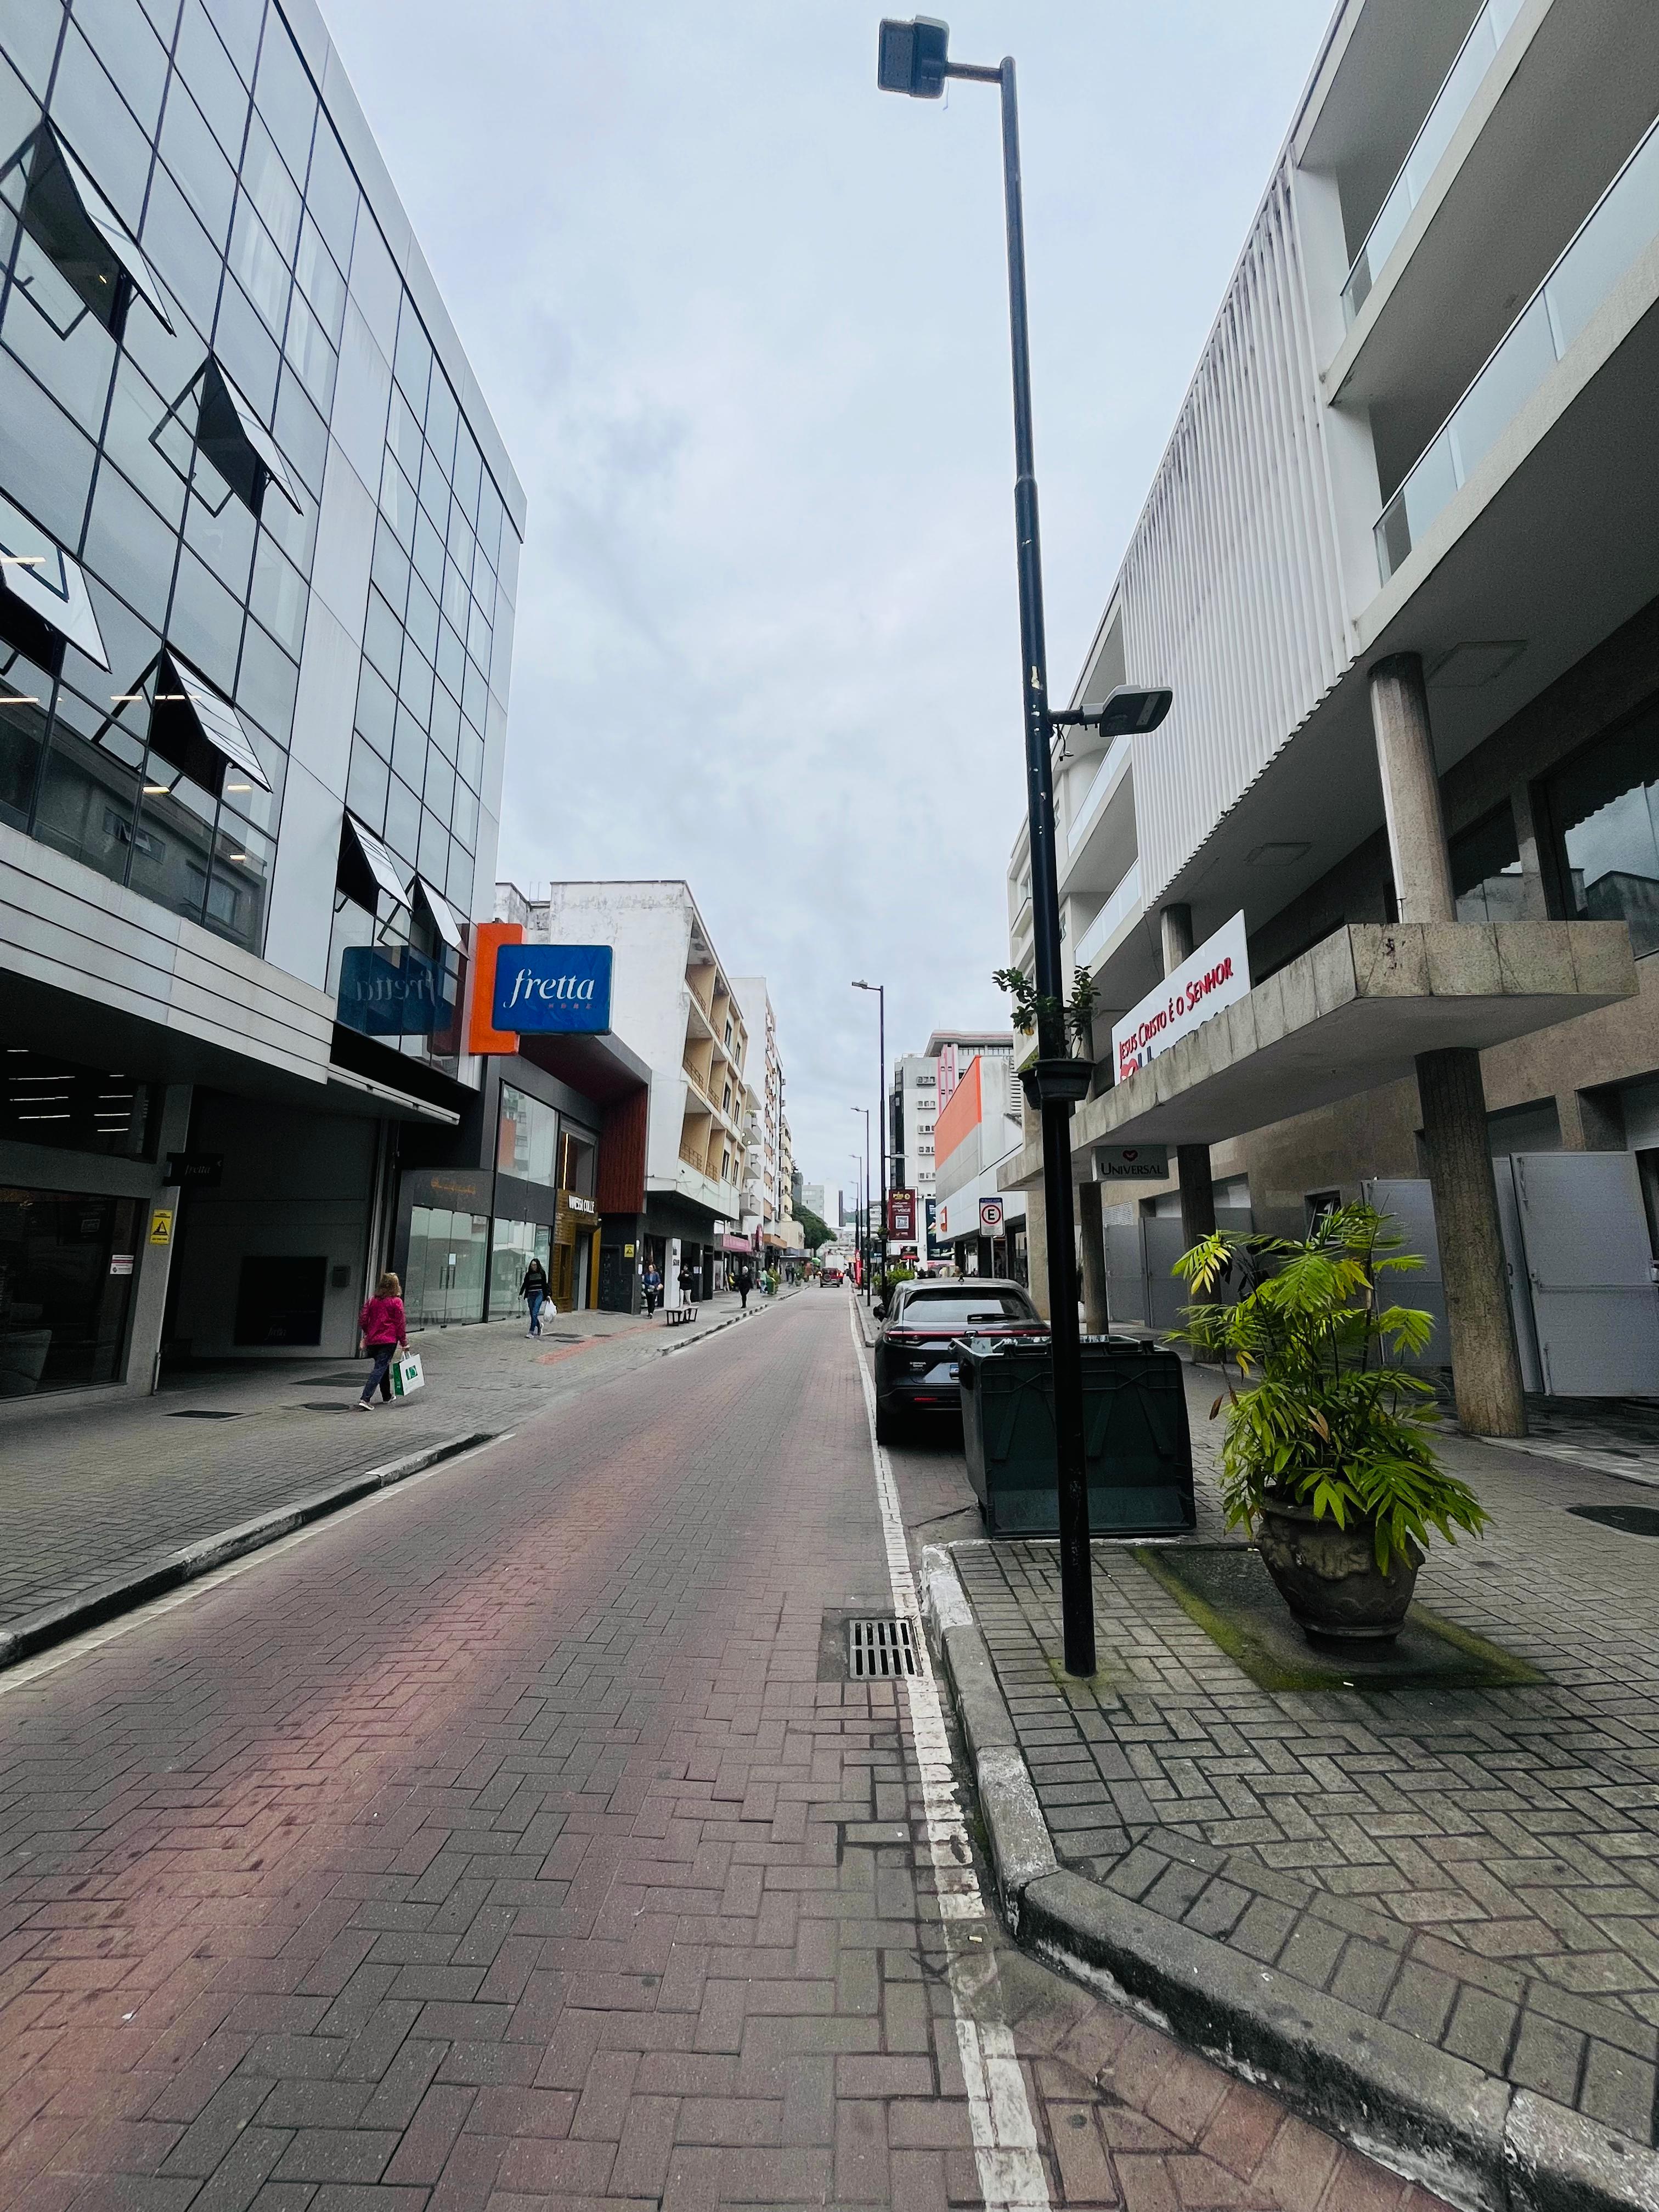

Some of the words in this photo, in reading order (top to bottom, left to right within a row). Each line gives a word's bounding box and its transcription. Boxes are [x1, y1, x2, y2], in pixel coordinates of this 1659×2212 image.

[503, 968, 595, 1008] fretta
[1119, 1033, 1137, 1067] JESUS
[1138, 1011, 1167, 1048] CRISTO
[1169, 997, 1175, 1023] É
[1176, 996, 1184, 1016] O
[1186, 957, 1234, 1011] SENHOR
[1101, 1163, 1163, 1175] UNIVERSAL
[988, 1209, 995, 1221] E
